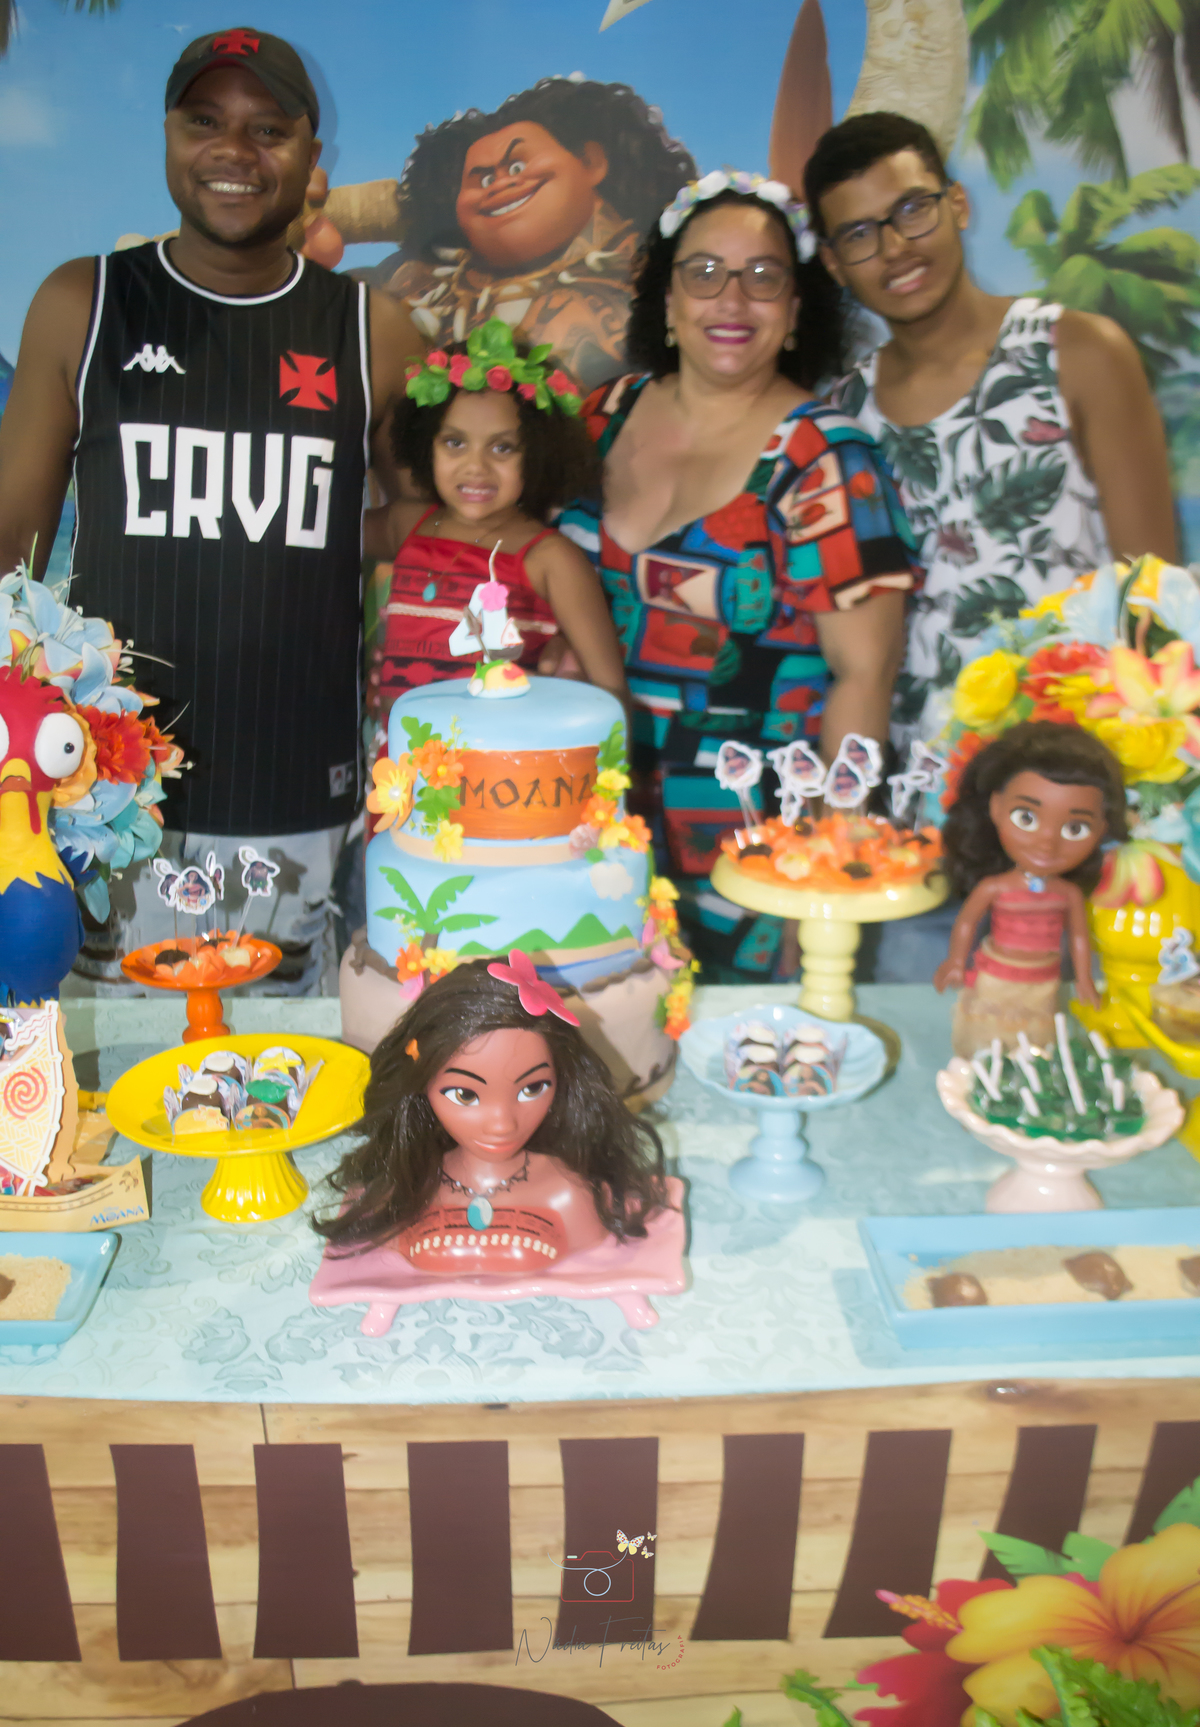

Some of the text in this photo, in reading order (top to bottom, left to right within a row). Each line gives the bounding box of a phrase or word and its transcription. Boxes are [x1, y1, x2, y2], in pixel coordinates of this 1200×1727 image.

[120, 423, 336, 549] CRVG
[459, 772, 594, 809] MOANA
[90, 1205, 144, 1227] MOANA
